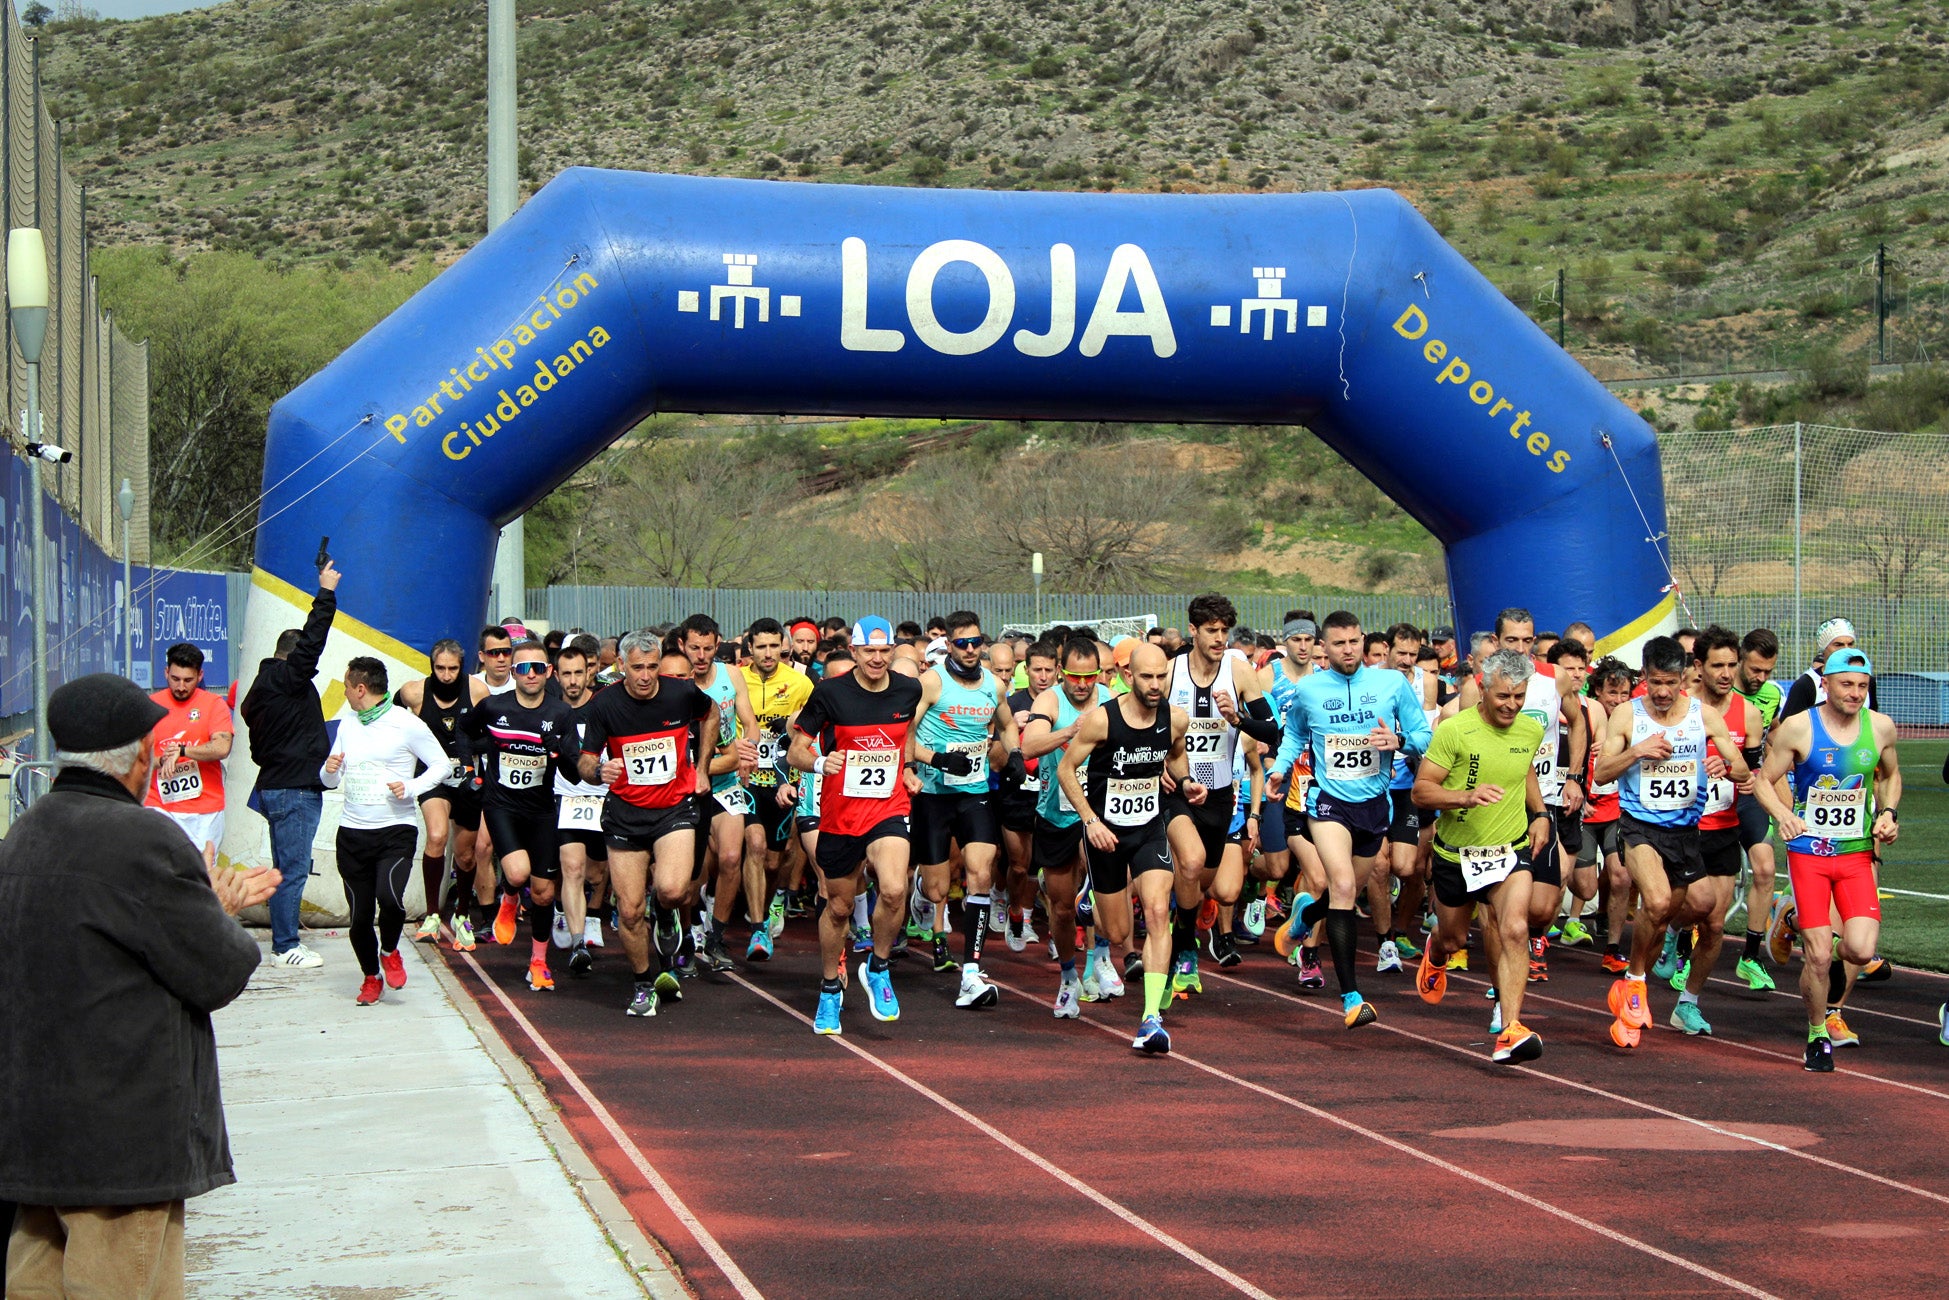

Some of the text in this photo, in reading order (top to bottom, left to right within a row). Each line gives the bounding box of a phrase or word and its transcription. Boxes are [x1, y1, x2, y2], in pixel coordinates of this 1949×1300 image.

[841, 237, 1177, 358] LOJA
[384, 270, 600, 445] Participación
[440, 321, 613, 462] Ciudadana
[1392, 303, 1573, 475] Deportes
[1329, 708, 1375, 724] nerja
[1190, 722, 1219, 730] ONDO
[634, 742, 665, 753] FONDO
[1185, 735, 1221, 752] 827
[1336, 737, 1370, 746] FONDO
[508, 757, 539, 767] FONDO
[632, 755, 668, 775] 371
[858, 754, 892, 763] FONDO
[1112, 751, 1152, 764] ALEJANDRO
[1333, 749, 1372, 768] 258
[509, 769, 533, 785] 66
[859, 768, 886, 786] 23
[1465, 753, 1480, 791] VERDE
[1653, 765, 1688, 774] FONDO
[161, 775, 199, 795] 3020
[1119, 782, 1152, 791] FONDO
[1649, 779, 1690, 799] 543
[1109, 795, 1155, 815] 3036
[1820, 794, 1856, 802] FONDO
[572, 807, 594, 820] 20
[1814, 807, 1856, 827] 938
[1471, 858, 1507, 876] 327
